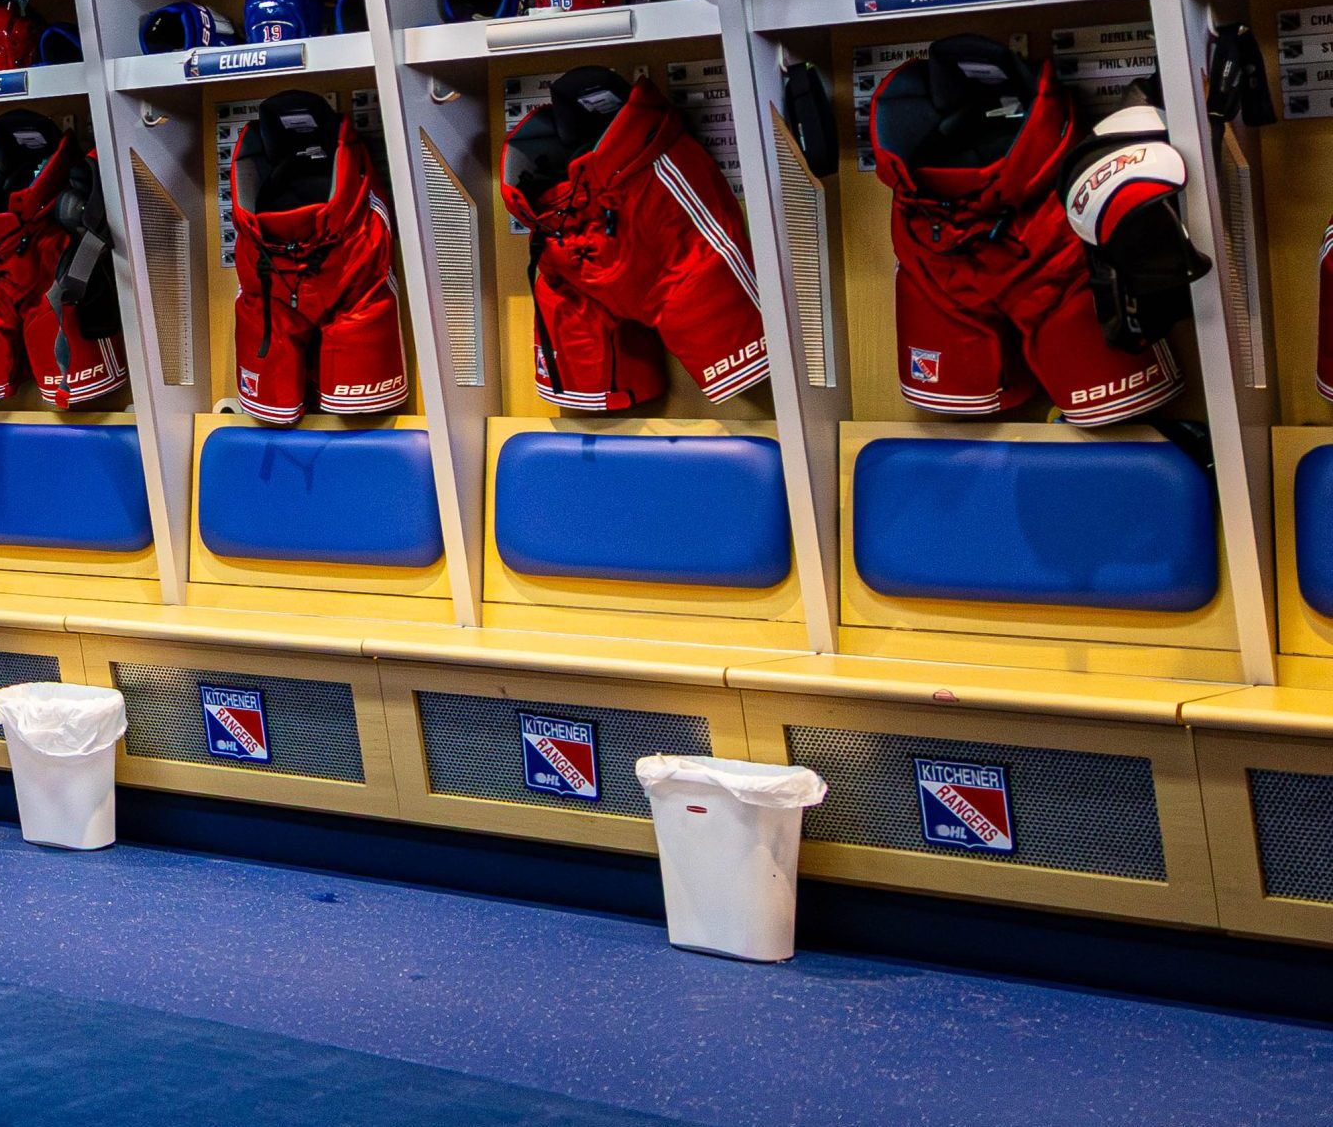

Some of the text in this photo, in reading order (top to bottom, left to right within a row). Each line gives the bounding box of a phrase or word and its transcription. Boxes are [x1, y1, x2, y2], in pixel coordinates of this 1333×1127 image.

[263, 25, 282, 42] 19
[219, 51, 267, 70] ELLINAS
[1071, 148, 1147, 216] CCM
[333, 374, 403, 397] BAUER
[205, 689, 259, 710] KITCHENER
[215, 707, 258, 754] RANGERS
[525, 718, 589, 742] KITCHENER
[535, 736, 585, 791] RANGERS
[920, 762, 1000, 788] KITCHENER
[935, 783, 998, 843] RANGERS
